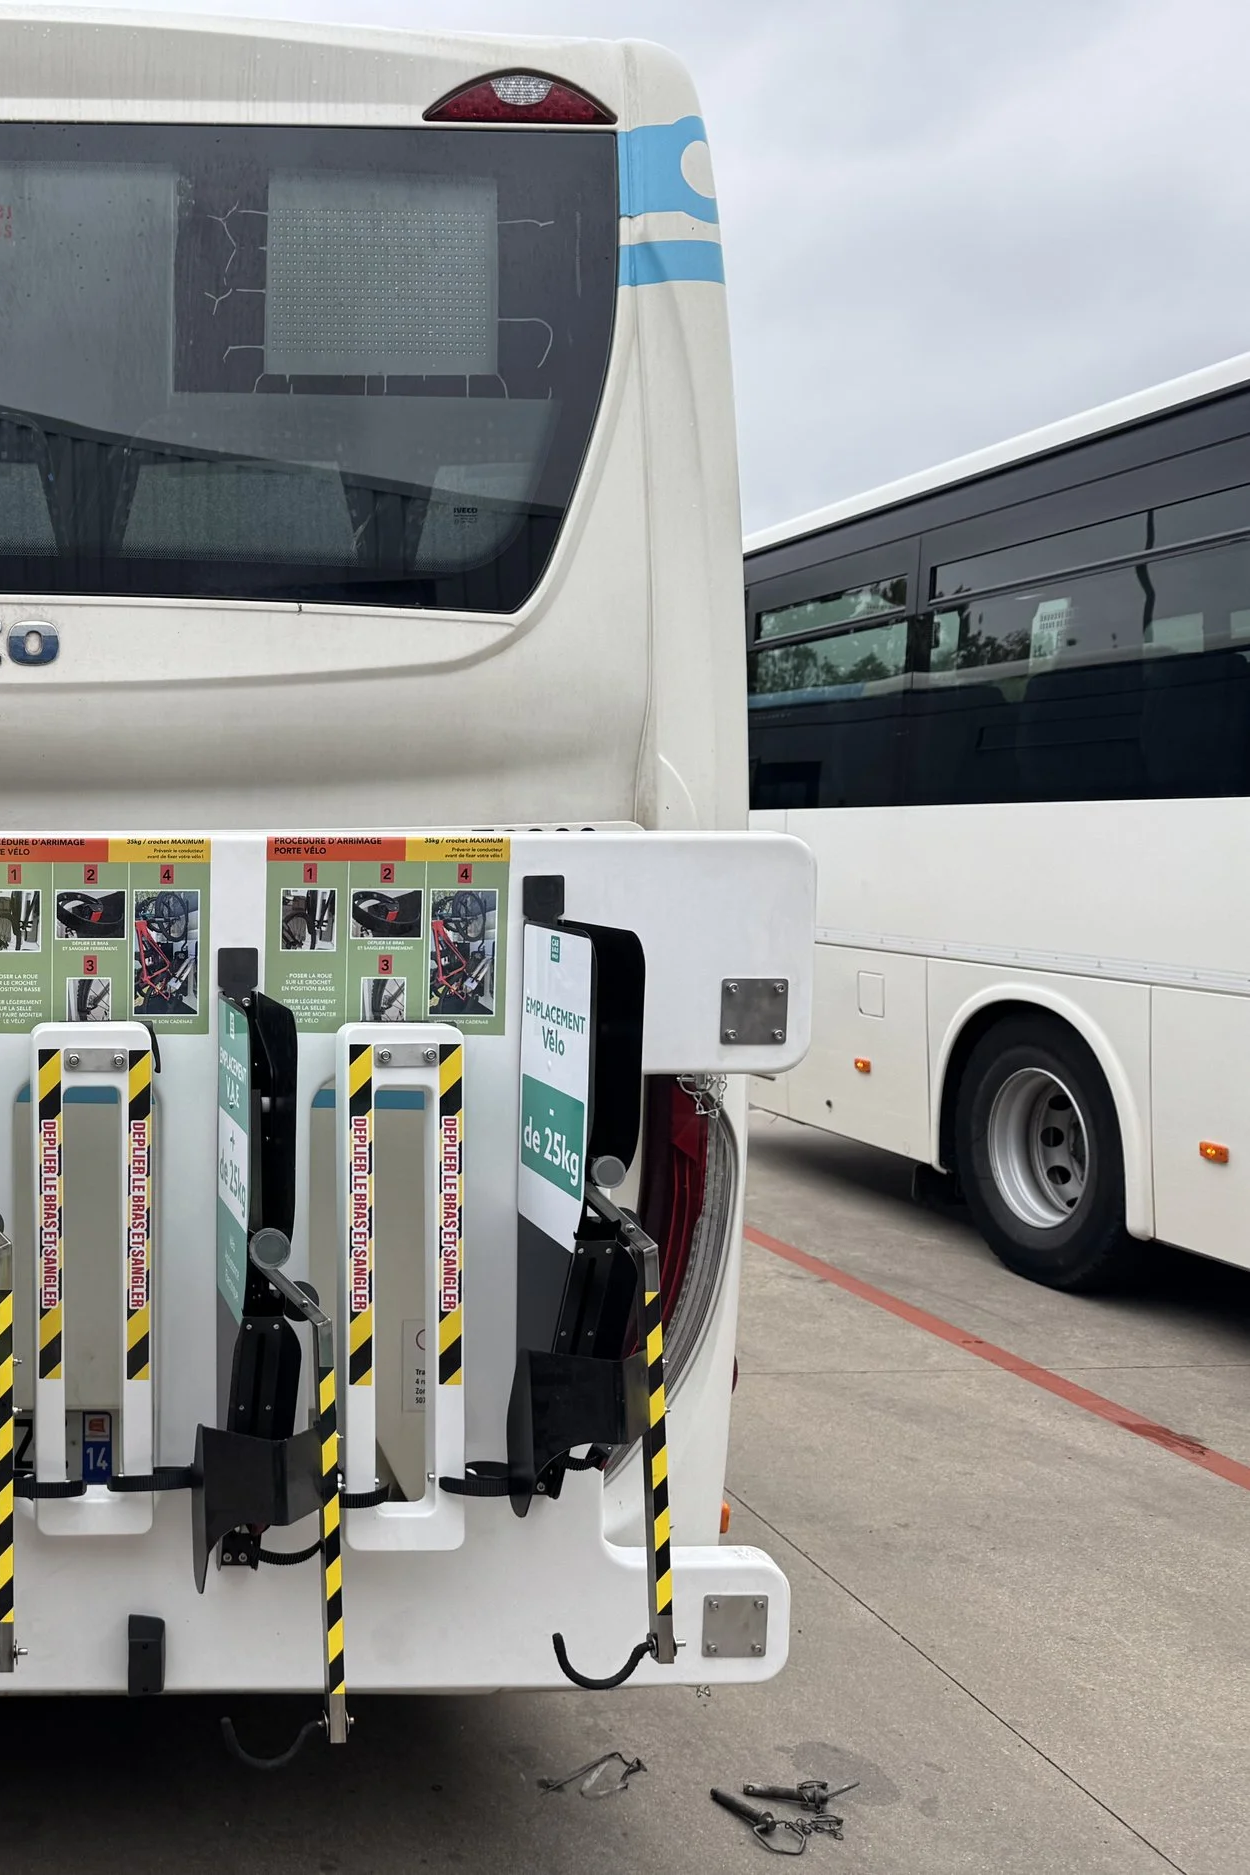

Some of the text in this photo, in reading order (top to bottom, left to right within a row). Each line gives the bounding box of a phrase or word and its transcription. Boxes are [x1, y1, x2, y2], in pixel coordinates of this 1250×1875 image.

[31, 838, 85, 846] D'ARRIMAGE
[274, 837, 382, 845] PROCÉDURE D'ARRIMAGE
[7, 846, 30, 856] VÉLO
[304, 845, 327, 855] VÉLO
[11, 869, 17, 881] 1
[86, 869, 95, 881] 2
[163, 869, 171, 881] 4
[306, 868, 312, 880] 1
[383, 868, 392, 880] 2
[460, 868, 469, 880] 4
[86, 960, 94, 972] 3
[381, 959, 389, 971] 3
[526, 996, 586, 1034] EMPLACEMENT
[542, 1025, 565, 1056] Vélo
[523, 1116, 580, 1188] de 25kg
[219, 1151, 228, 1186] de
[229, 1156, 247, 1218] 25kg
[43, 1121, 57, 1307] DEPLIER LE BRAS ET SANGLER
[131, 1122, 146, 1307] DEPLIER LE BRAS ET SANGLER
[353, 1118, 367, 1310] DEPLIER LE BRAS ET SANGLER
[443, 1118, 457, 1310] DEPLIER LE BRAS ET SANGLER
[86, 1447, 108, 1471] 14
